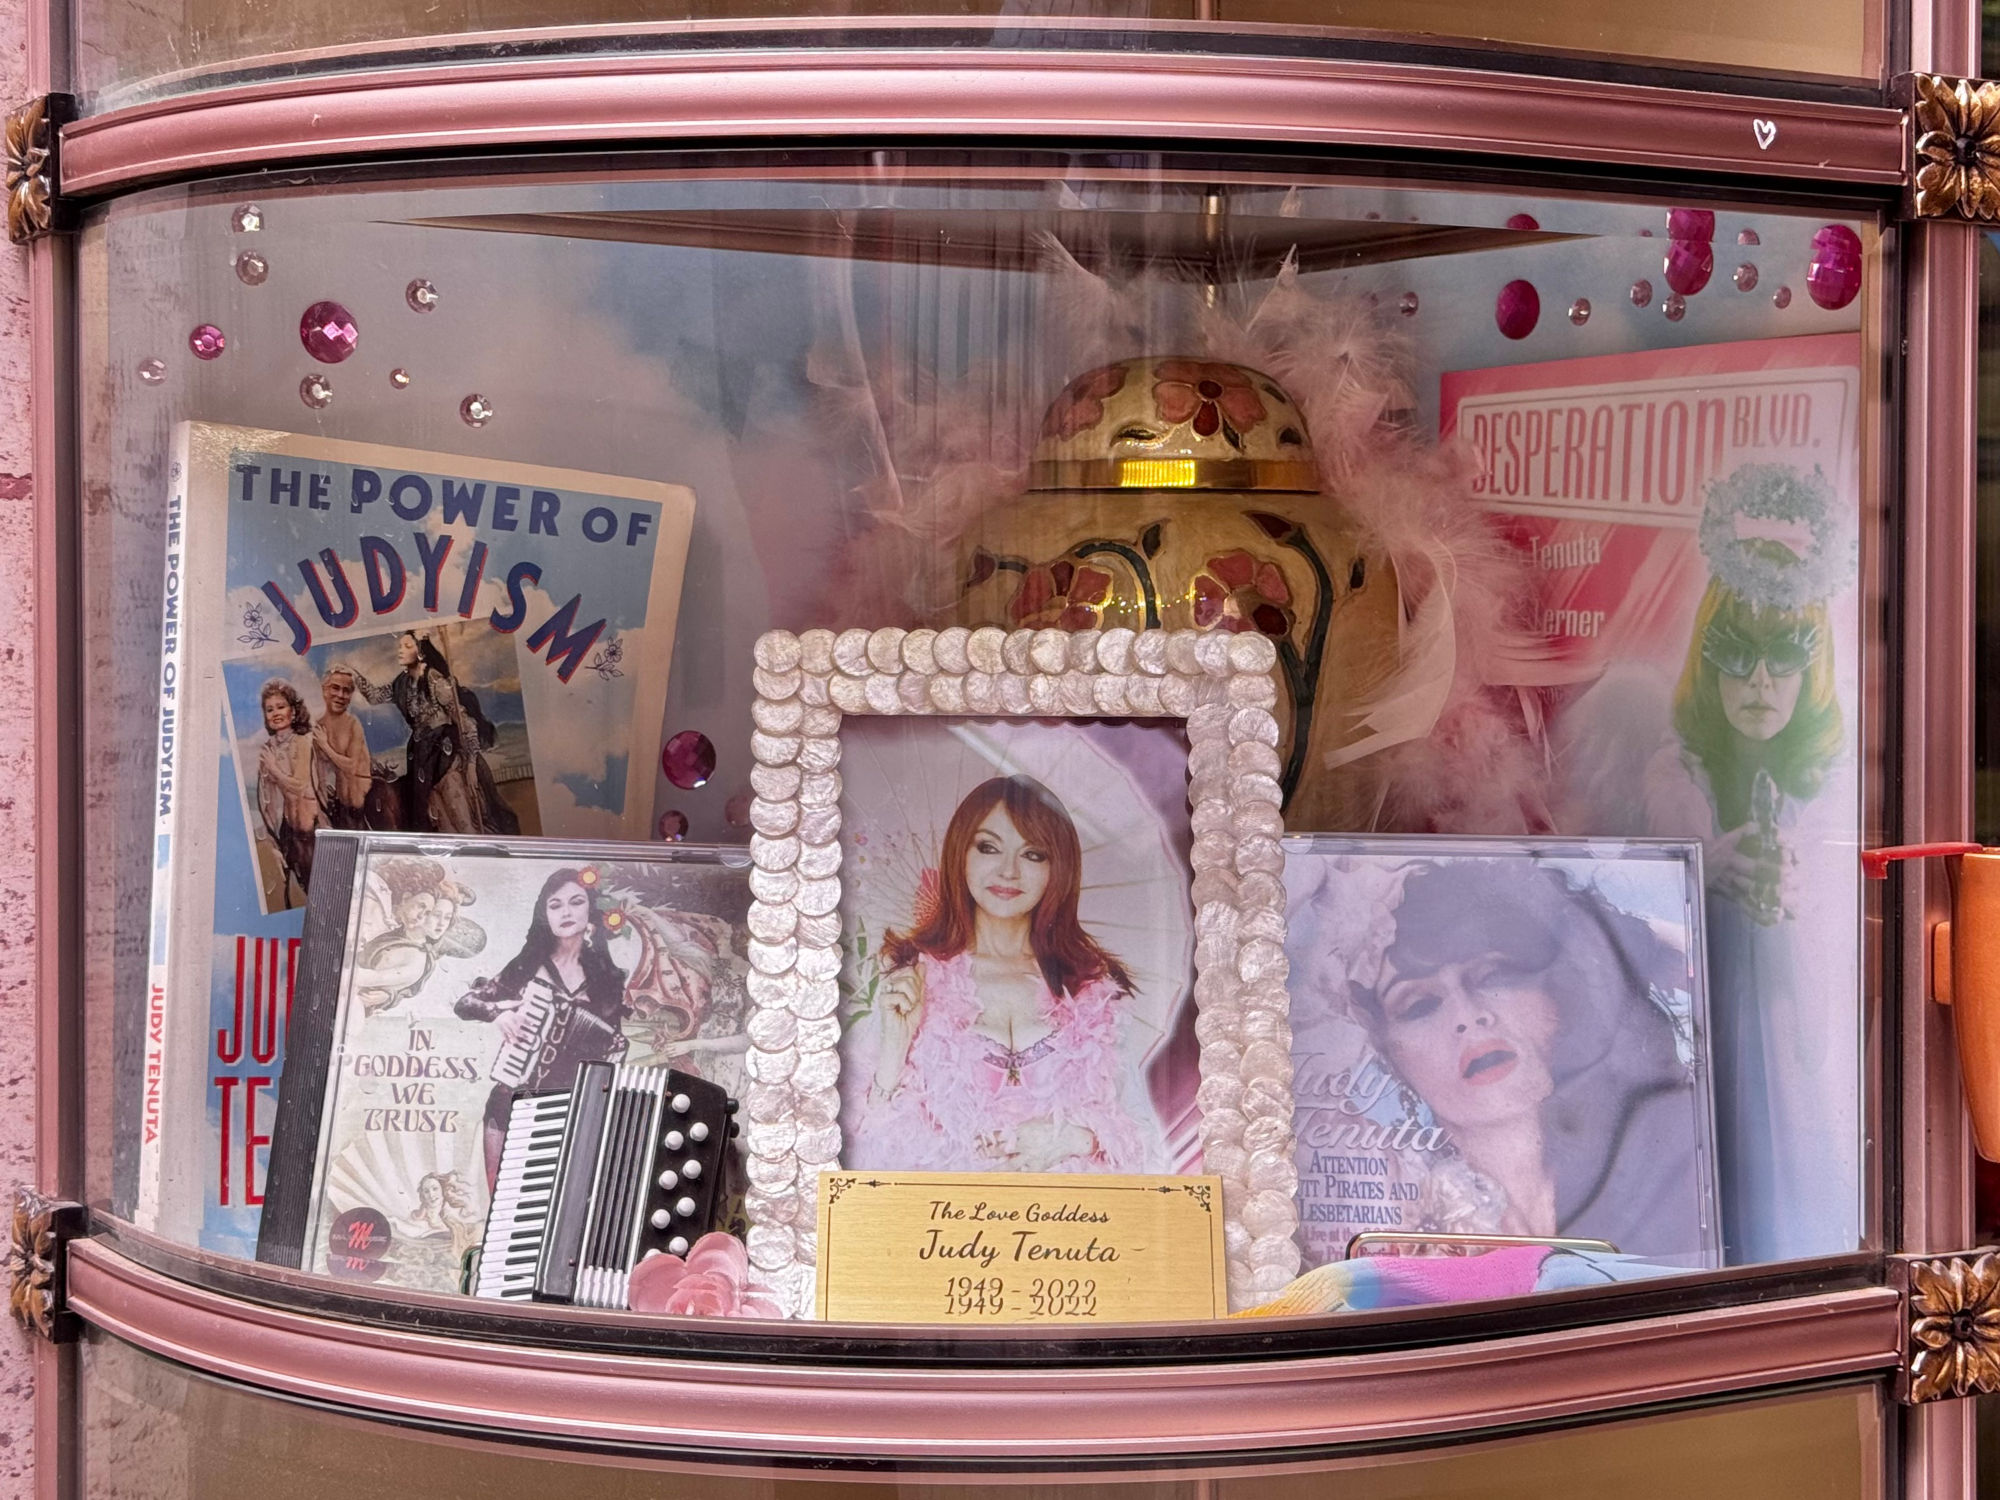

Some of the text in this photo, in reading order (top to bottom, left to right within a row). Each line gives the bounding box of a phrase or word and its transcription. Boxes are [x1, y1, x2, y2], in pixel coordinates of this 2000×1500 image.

[1732, 393, 1820, 448] BLVD.
[236, 464, 652, 547] THE POWER OF
[1529, 531, 1601, 569] Tenuta
[261, 532, 608, 685] JUDYISM
[1543, 607, 1605, 639] erner
[159, 495, 181, 817] THE POWER OF JUDYISM
[409, 1029, 433, 1052] IN
[145, 983, 164, 1145] JUDY TENUTA
[354, 1054, 478, 1080] GODDESS
[391, 1082, 436, 1106] WE
[364, 1108, 459, 1134] TRUST
[1294, 1105, 1452, 1152] Tenuta
[1309, 1150, 1389, 1177] ATTENTION
[1325, 1175, 1385, 1201] PIRATES
[1389, 1183, 1419, 1202] AND
[929, 1201, 1111, 1224] The Love Goddess
[1299, 1199, 1402, 1226] LESBETARIANS
[919, 1229, 1120, 1269] Judy Tenuta
[944, 1276, 1004, 1298] 1949
[1029, 1278, 1097, 1299] 2022
